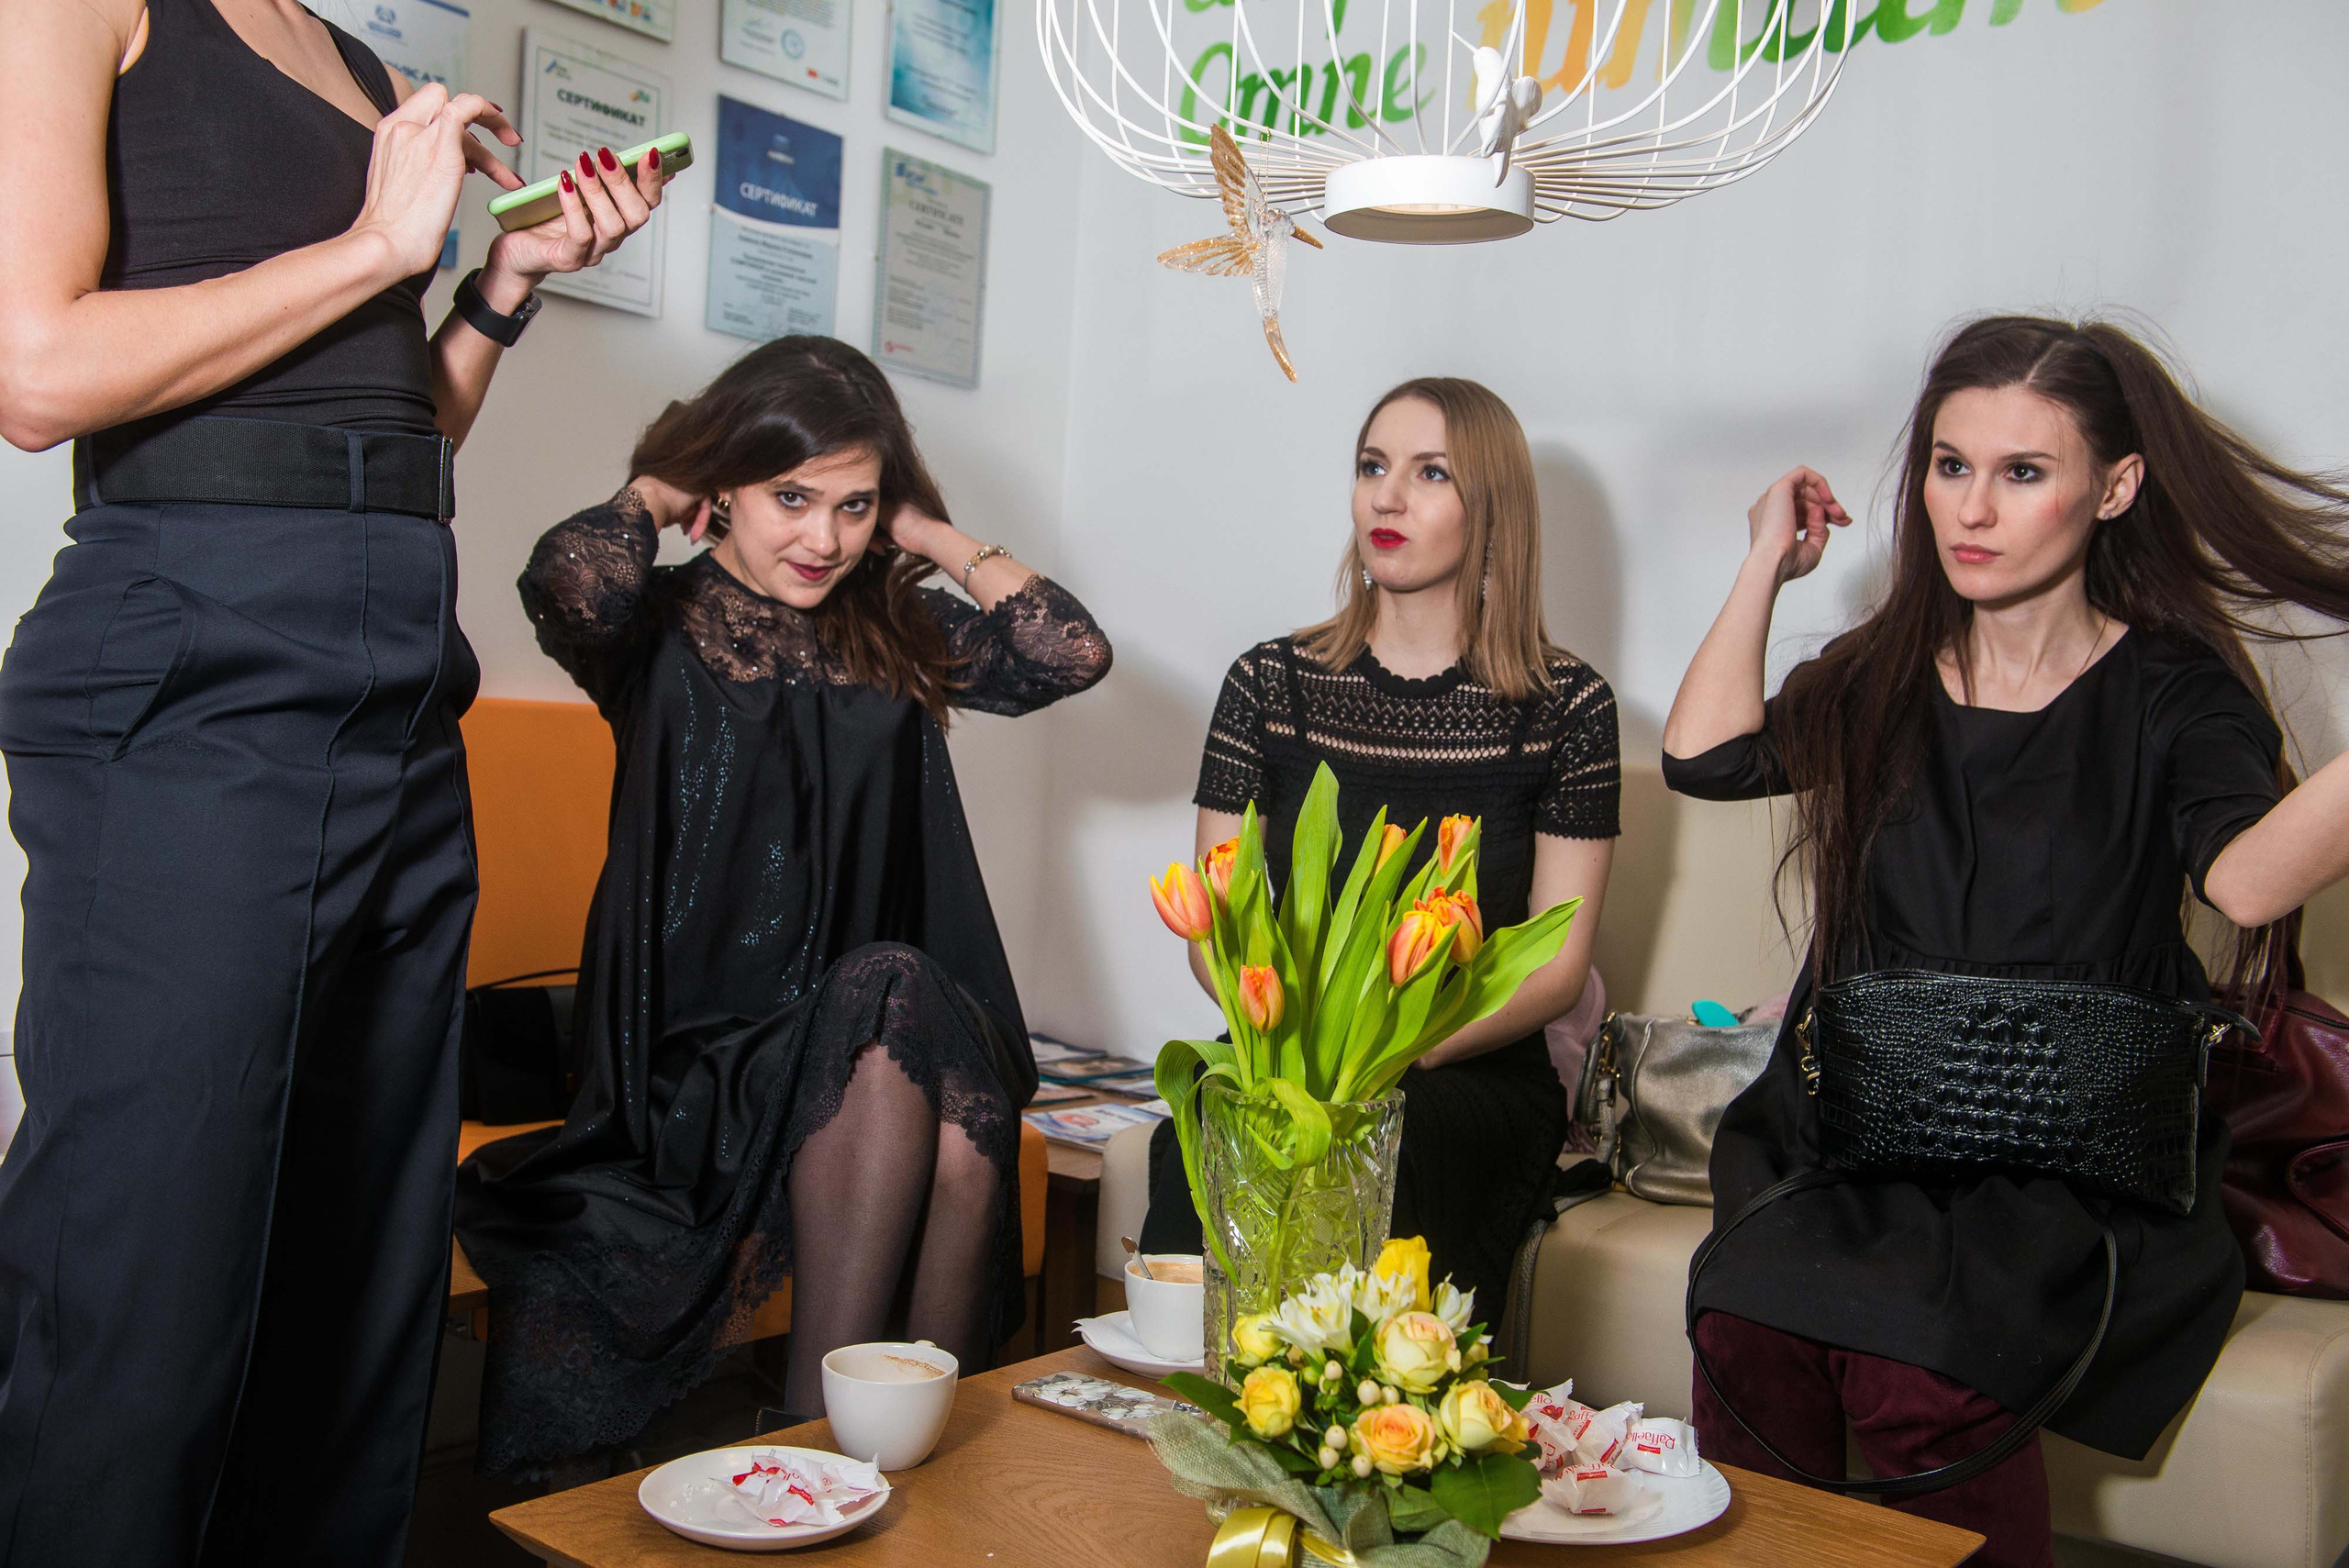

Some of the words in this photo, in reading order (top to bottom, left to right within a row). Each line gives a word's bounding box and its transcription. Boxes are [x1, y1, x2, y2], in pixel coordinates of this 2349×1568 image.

[556, 88, 646, 127] СЕРТИФИКАТ
[740, 182, 818, 217] СЕРТИФИКАТ
[1625, 1431, 1675, 1450] Raffaello
